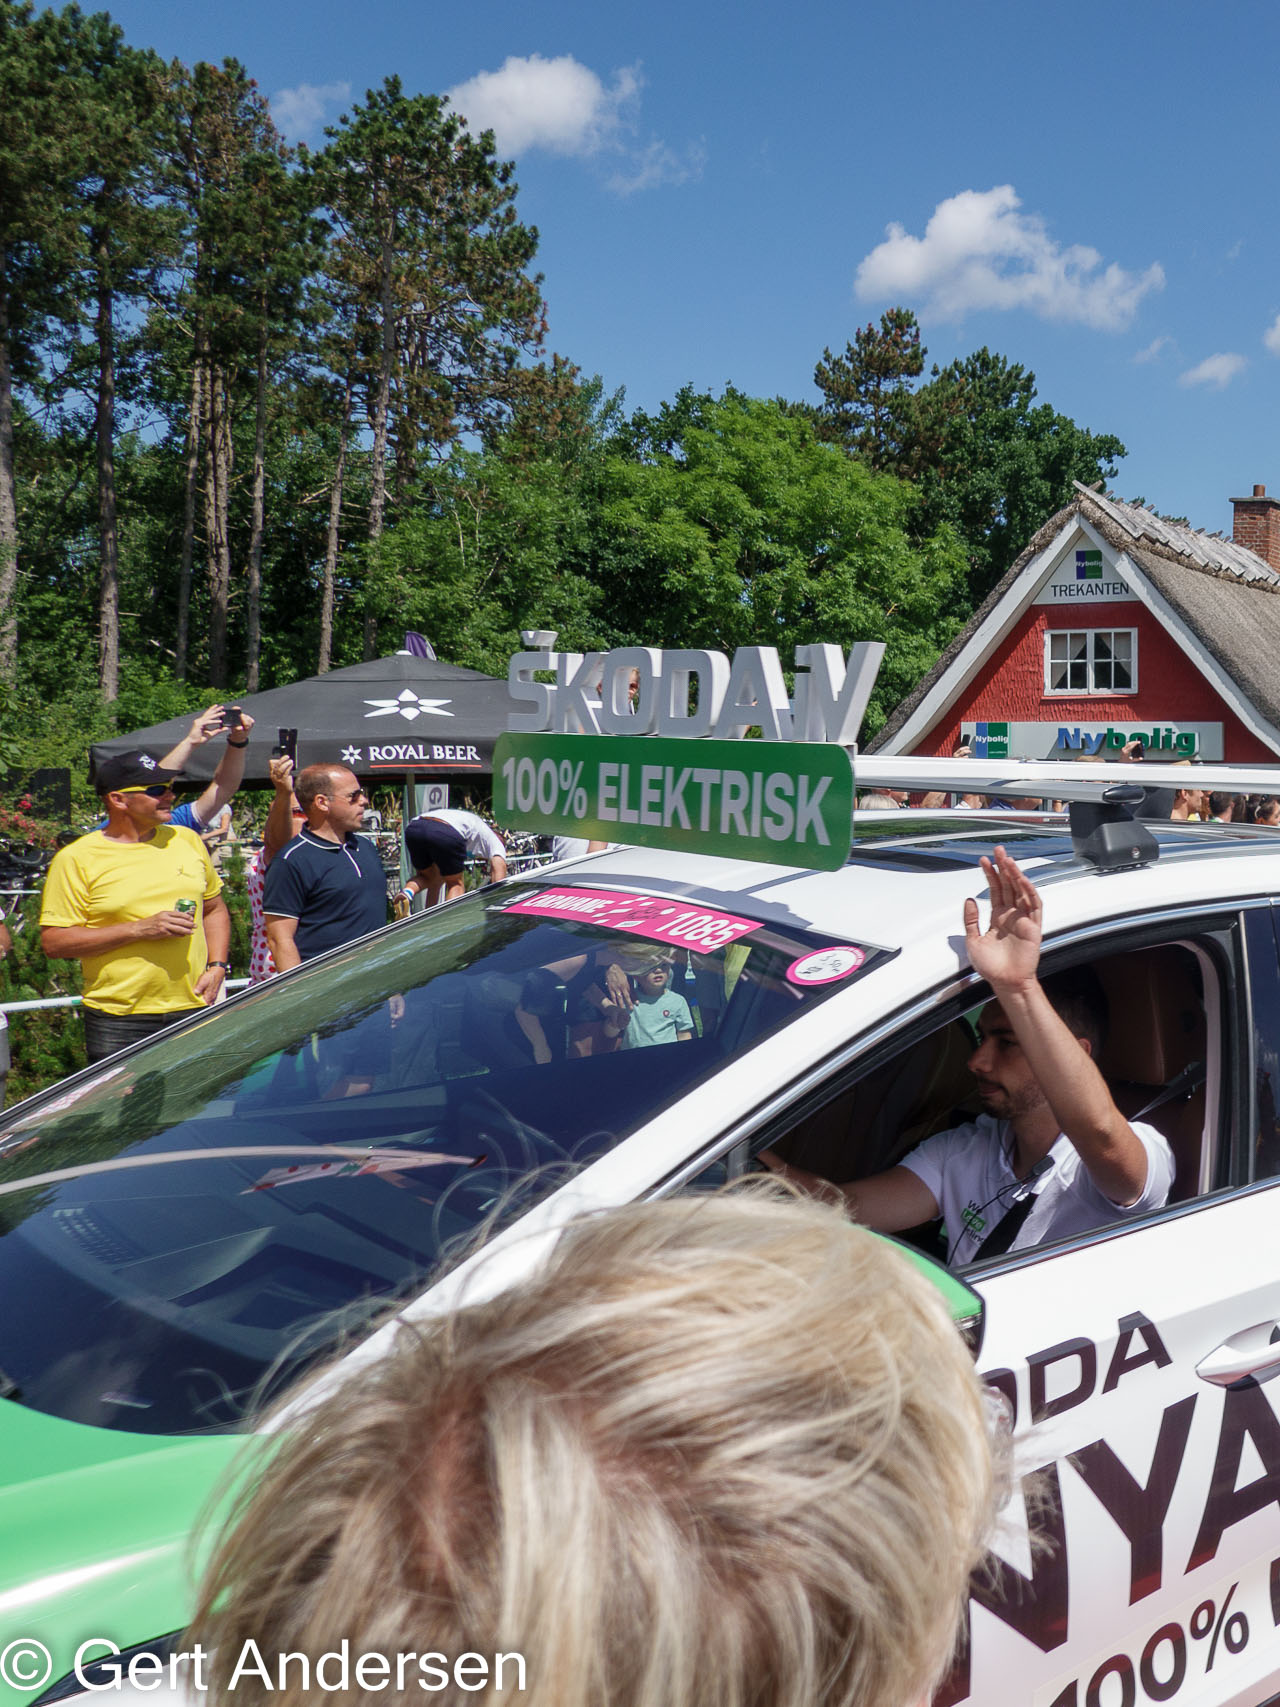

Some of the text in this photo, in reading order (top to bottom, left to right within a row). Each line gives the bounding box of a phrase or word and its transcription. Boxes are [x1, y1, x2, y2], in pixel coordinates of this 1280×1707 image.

[1050, 582, 1130, 598] TREKANTEN
[975, 735, 1009, 744] Nybolig
[1057, 727, 1200, 756] Nybolig
[368, 744, 481, 761] ROYAL BEER
[502, 756, 833, 847] 100% ELEKTRISK
[521, 893, 617, 915] CARAVANE
[654, 911, 750, 948] 1085
